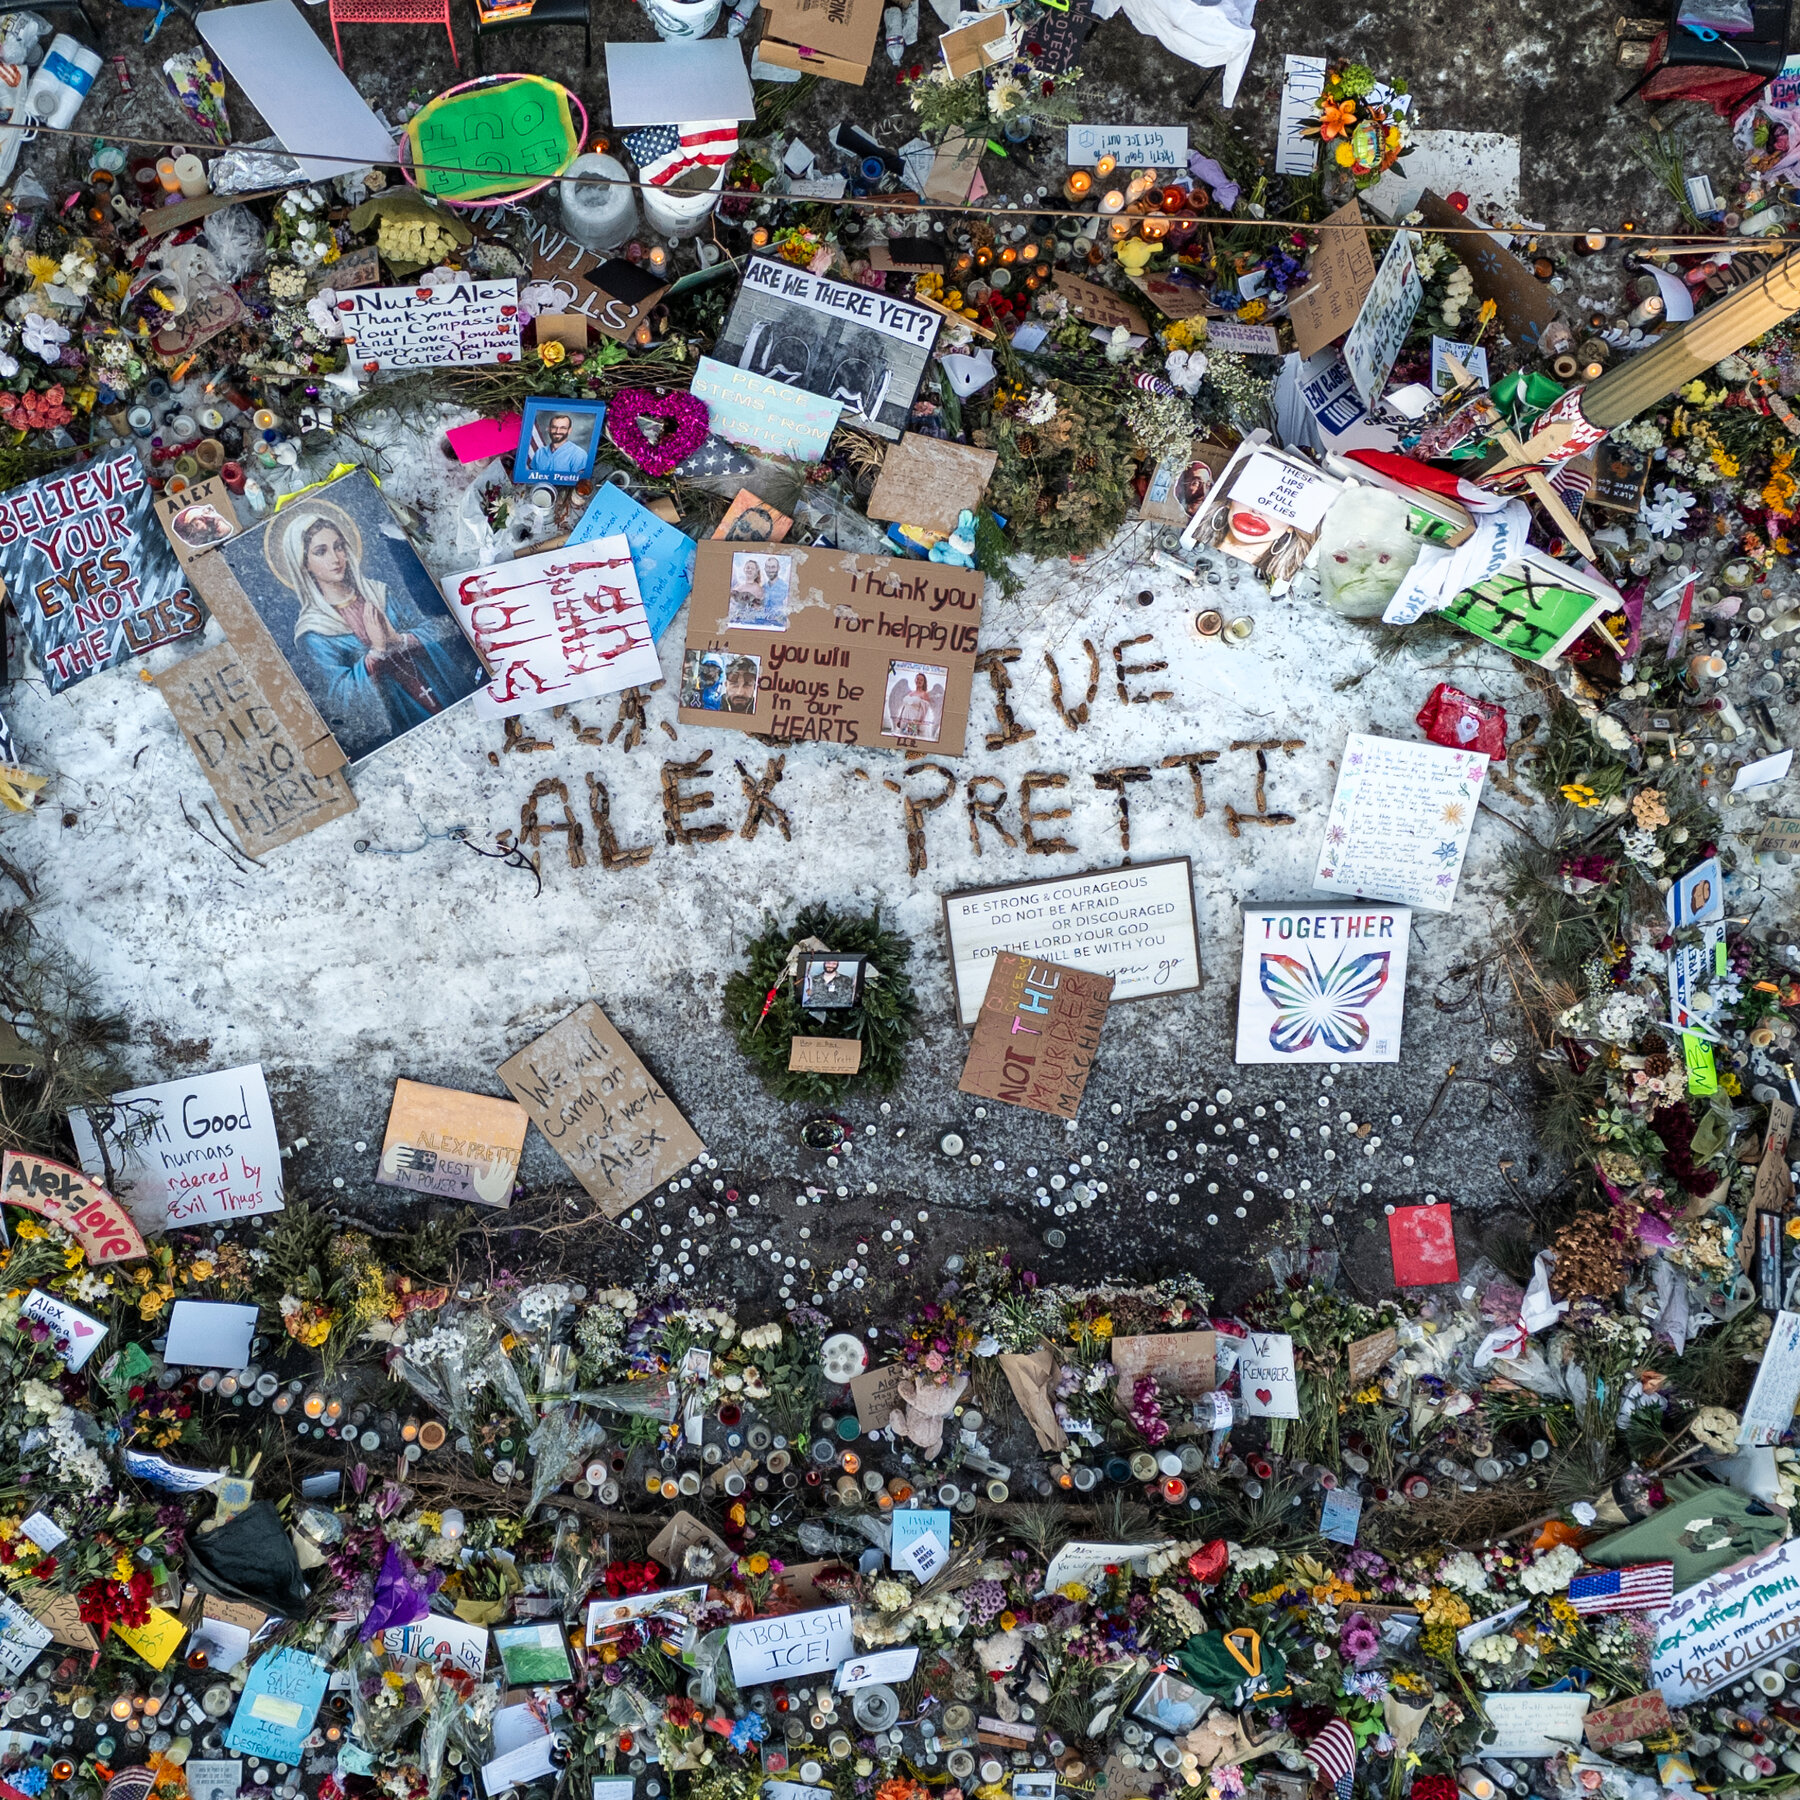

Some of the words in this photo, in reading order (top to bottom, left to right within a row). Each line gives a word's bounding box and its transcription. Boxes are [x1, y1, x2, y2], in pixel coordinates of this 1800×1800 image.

[420, 101, 544, 153] OUT
[1125, 133, 1140, 146] ICE
[1145, 131, 1164, 147] GET
[355, 292, 441, 312] Nurse
[446, 284, 516, 304] Alex
[746, 262, 781, 289] ARE
[782, 274, 810, 298] WE
[815, 281, 875, 318] THERE
[879, 300, 934, 342] YET?
[1068, 285, 1124, 313] ICE
[344, 311, 417, 326] Thank
[350, 325, 402, 340] Your
[1390, 285, 1420, 356] TODAY
[355, 337, 394, 348] and
[402, 334, 451, 346] Love
[356, 343, 446, 360] Everyone
[484, 338, 519, 348] have
[391, 349, 457, 366] Cared
[695, 380, 767, 411] STEMS
[732, 373, 811, 408] PEACE
[1303, 384, 1329, 411] ICE!
[1324, 397, 1360, 428] OUT!
[768, 414, 830, 441] FROM
[528, 472, 550, 481] Alex
[553, 473, 580, 482] Pretti
[1281, 476, 1305, 490] LIPS
[1282, 465, 1316, 485] THESE
[0, 455, 144, 547] BELIEVE
[167, 483, 214, 515] ALEX
[1269, 491, 1293, 508] FULL
[1276, 485, 1299, 499] ARE
[1257, 497, 1273, 506] OF
[1273, 504, 1297, 518] LIES
[31, 504, 133, 571] YOUR
[35, 547, 133, 621] EYES
[928, 585, 976, 611] you
[74, 579, 142, 633] NOT
[45, 630, 113, 680] THE
[121, 588, 204, 655] LIES
[878, 612, 947, 652] helppig
[950, 625, 979, 653] US
[768, 644, 809, 671] you
[813, 647, 851, 669] will
[188, 663, 250, 717] HE
[757, 671, 829, 702] always
[837, 678, 865, 701] be
[772, 693, 791, 712] in
[807, 699, 844, 717] our
[771, 715, 859, 745] HEARTS
[238, 745, 296, 790] NO
[520, 748, 792, 872] ALEX
[902, 738, 1306, 877] PRETTI
[1766, 821, 1776, 833] A
[1761, 837, 1786, 849] REST
[962, 903, 980, 915] BE
[983, 894, 1040, 912] STRONG
[1043, 892, 1051, 902] &
[1053, 877, 1148, 901] COURAGEOUS
[991, 913, 1011, 926] DO
[1016, 908, 1044, 921] NOT
[1049, 904, 1067, 916] BE
[1070, 896, 1120, 912] AFRAID
[1052, 919, 1072, 931] OR
[1076, 902, 1176, 927] DISCOURAGED
[972, 946, 999, 960] FOR
[1003, 940, 1031, 953] THE
[1035, 934, 1071, 950] LORD
[1075, 928, 1115, 942] YOUR
[1118, 922, 1150, 935] GOD
[1262, 915, 1395, 940] TOGETHER
[1073, 946, 1092, 958] BE
[1096, 940, 1132, 955] WITH
[1134, 935, 1166, 948] YOU
[1005, 957, 1032, 1011] QUEENS
[1154, 957, 1186, 985] go
[1011, 966, 1060, 1035] THE
[1027, 975, 1087, 1109] MURDER
[1057, 991, 1108, 1113] MACHINE
[798, 1050, 830, 1064] ALEX
[515, 1062, 569, 1111] We
[601, 1064, 627, 1093] on
[998, 1045, 1036, 1103] NOT
[182, 1086, 252, 1139] Good
[621, 1082, 666, 1121] work
[160, 1143, 235, 1169] humans
[417, 1131, 467, 1156] ALEX
[242, 1155, 262, 1187] by
[439, 1159, 473, 1177] REST
[600, 1129, 666, 1188] Alex
[396, 1169, 412, 1182] IN
[418, 1173, 457, 1192] POWER
[7, 1157, 83, 1198] Alex
[70, 1200, 133, 1259] Love
[167, 1189, 208, 1219] Evil
[214, 1187, 264, 1213] Thugs
[901, 1527, 917, 1535] You
[914, 1516, 936, 1526] Wish
[1746, 1547, 1791, 1580] Good
[734, 1612, 844, 1650] ABOLISH
[1689, 1634, 1731, 1661] their
[1733, 1608, 1785, 1640] memories
[461, 1642, 482, 1671] FOR
[764, 1638, 831, 1671] ICE!
[266, 1671, 307, 1693] SAVE
[266, 1686, 296, 1700] LIVES
[256, 1719, 284, 1736] ICE
[232, 1734, 271, 1755] DESTROY
[272, 1749, 301, 1766] LIVES
